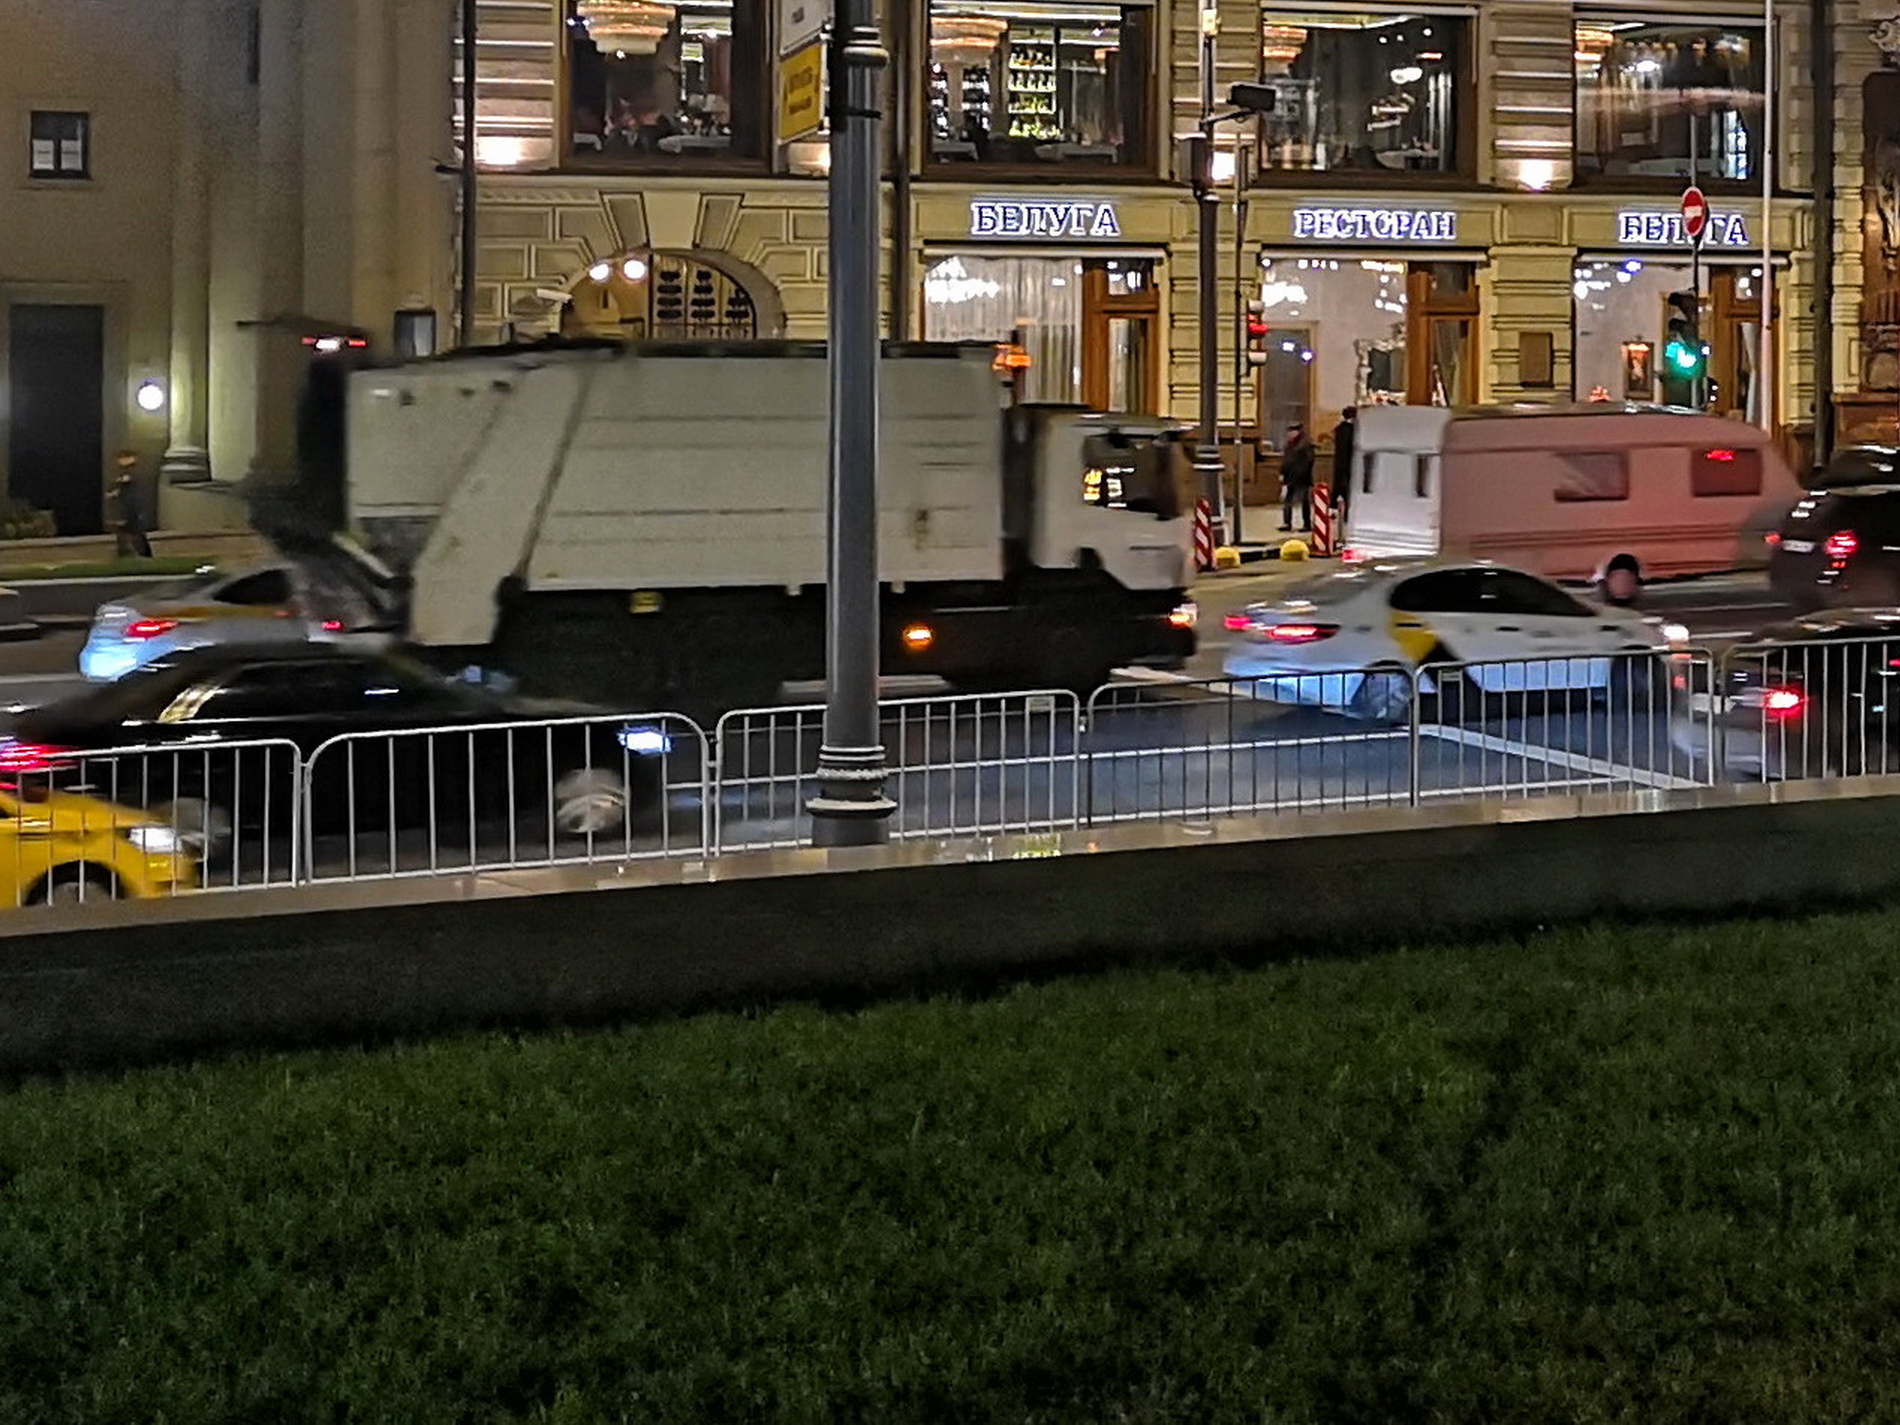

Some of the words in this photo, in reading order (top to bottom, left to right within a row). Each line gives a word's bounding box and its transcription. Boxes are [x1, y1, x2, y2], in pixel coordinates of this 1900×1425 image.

[971, 203, 1120, 236] БЕЛУГА
[1293, 209, 1457, 240] РЕСТОРАН
[1618, 213, 1749, 246] БЕЛГА
